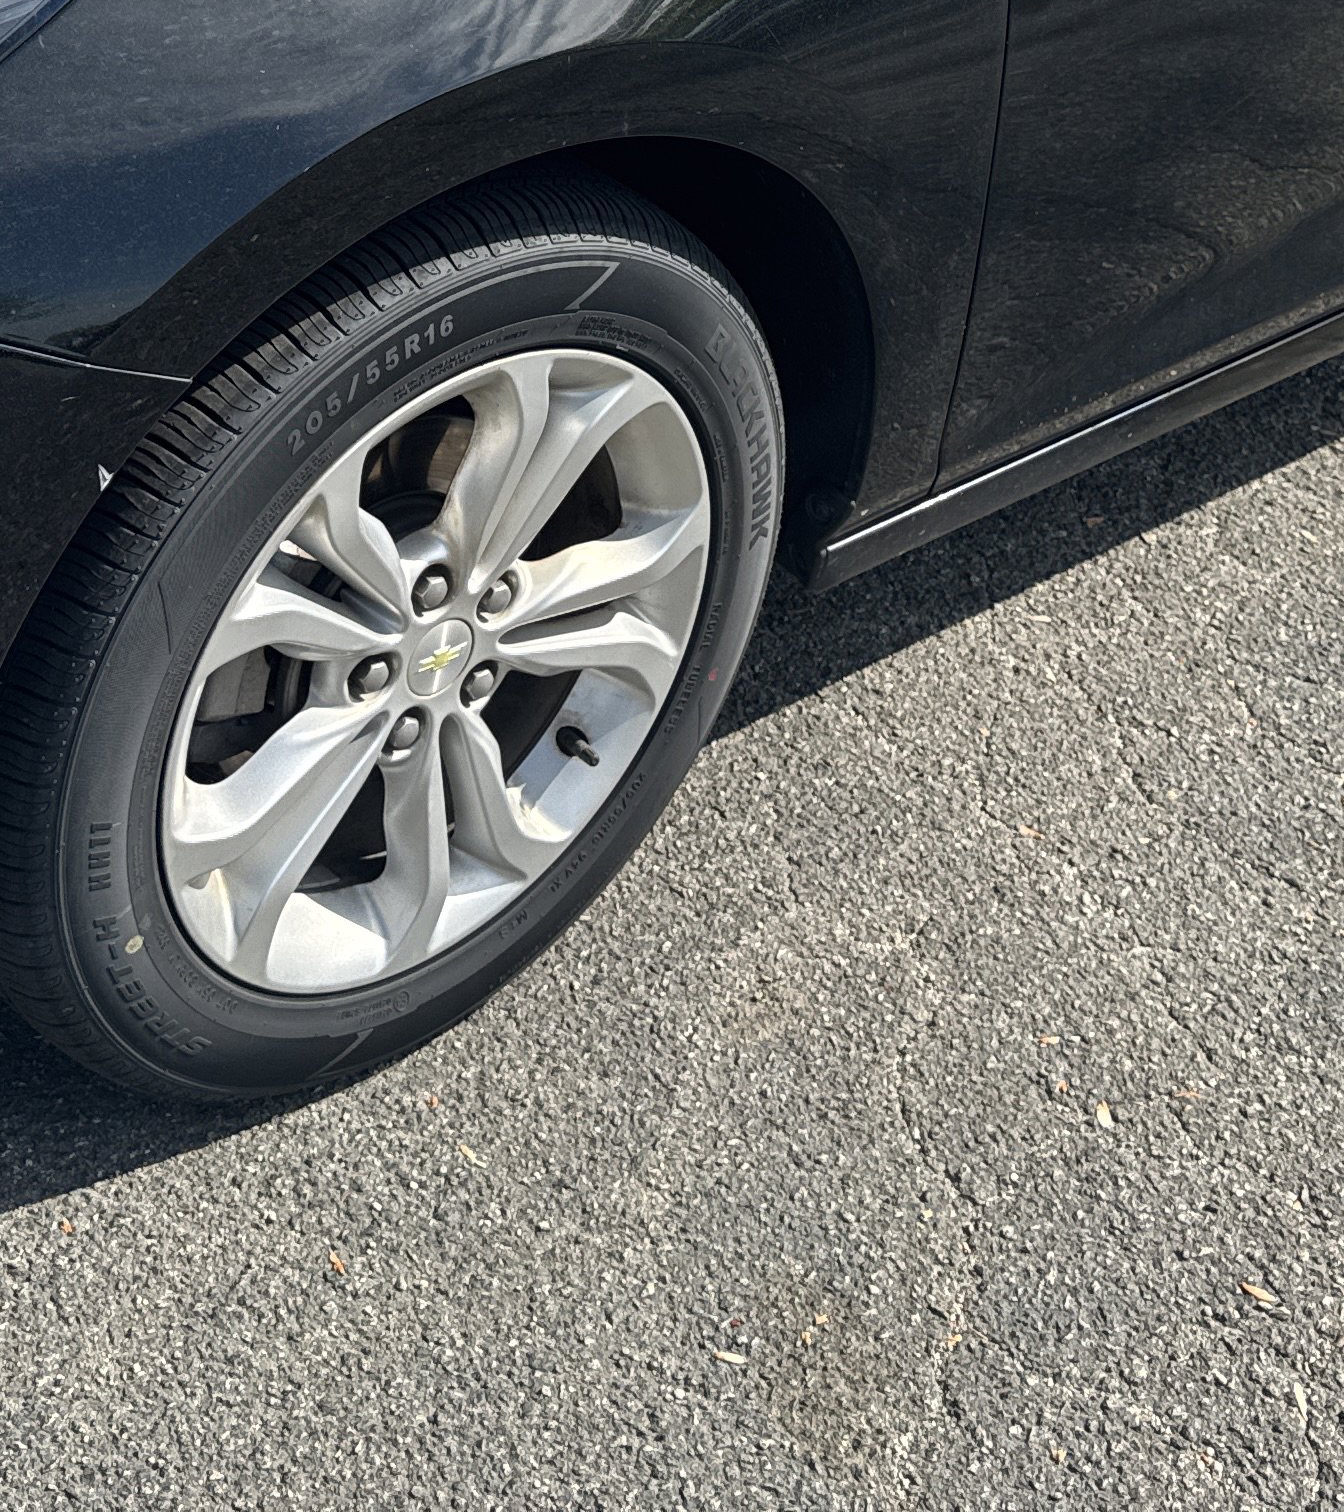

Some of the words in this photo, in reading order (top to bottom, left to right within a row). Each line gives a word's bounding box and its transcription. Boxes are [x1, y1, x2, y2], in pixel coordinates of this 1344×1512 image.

[286, 313, 455, 457] 205/55R16
[704, 322, 774, 552] BLACKHAWK
[92, 914, 213, 1057] STREET-H
